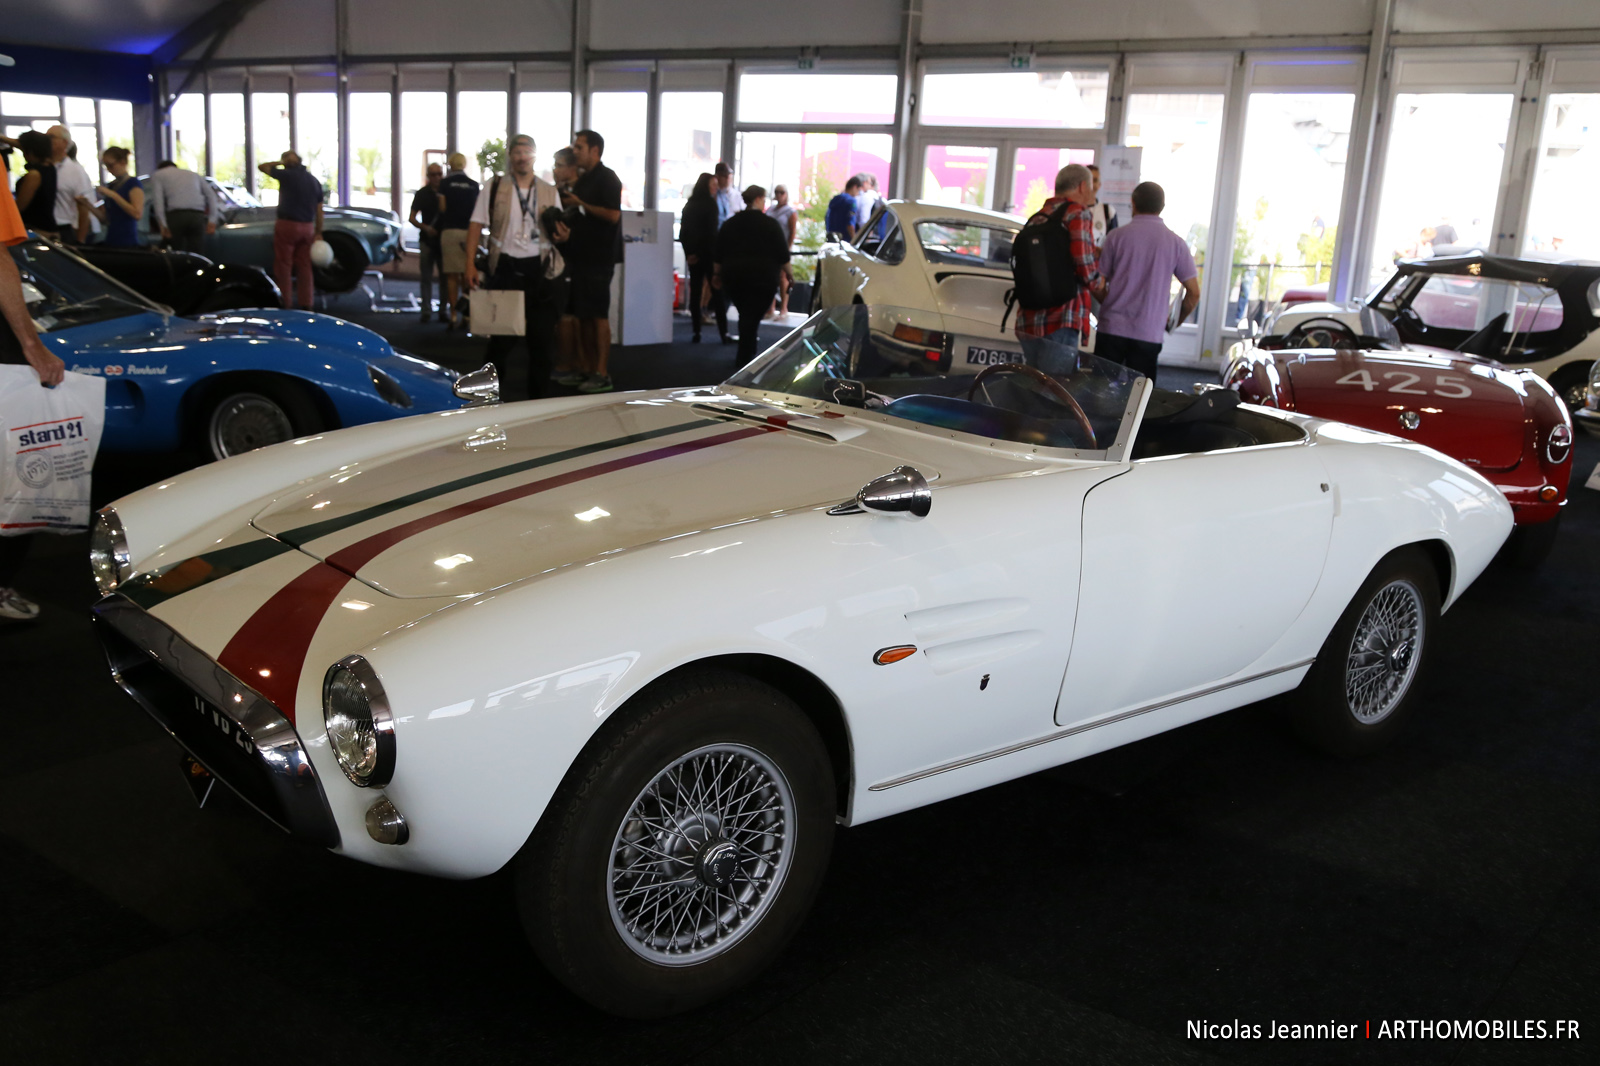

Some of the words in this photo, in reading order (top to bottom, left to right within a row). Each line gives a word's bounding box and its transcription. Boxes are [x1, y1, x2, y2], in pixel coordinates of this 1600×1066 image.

[1335, 369, 1472, 398] 425
[19, 425, 66, 446] stand
[67, 421, 83, 439] 21
